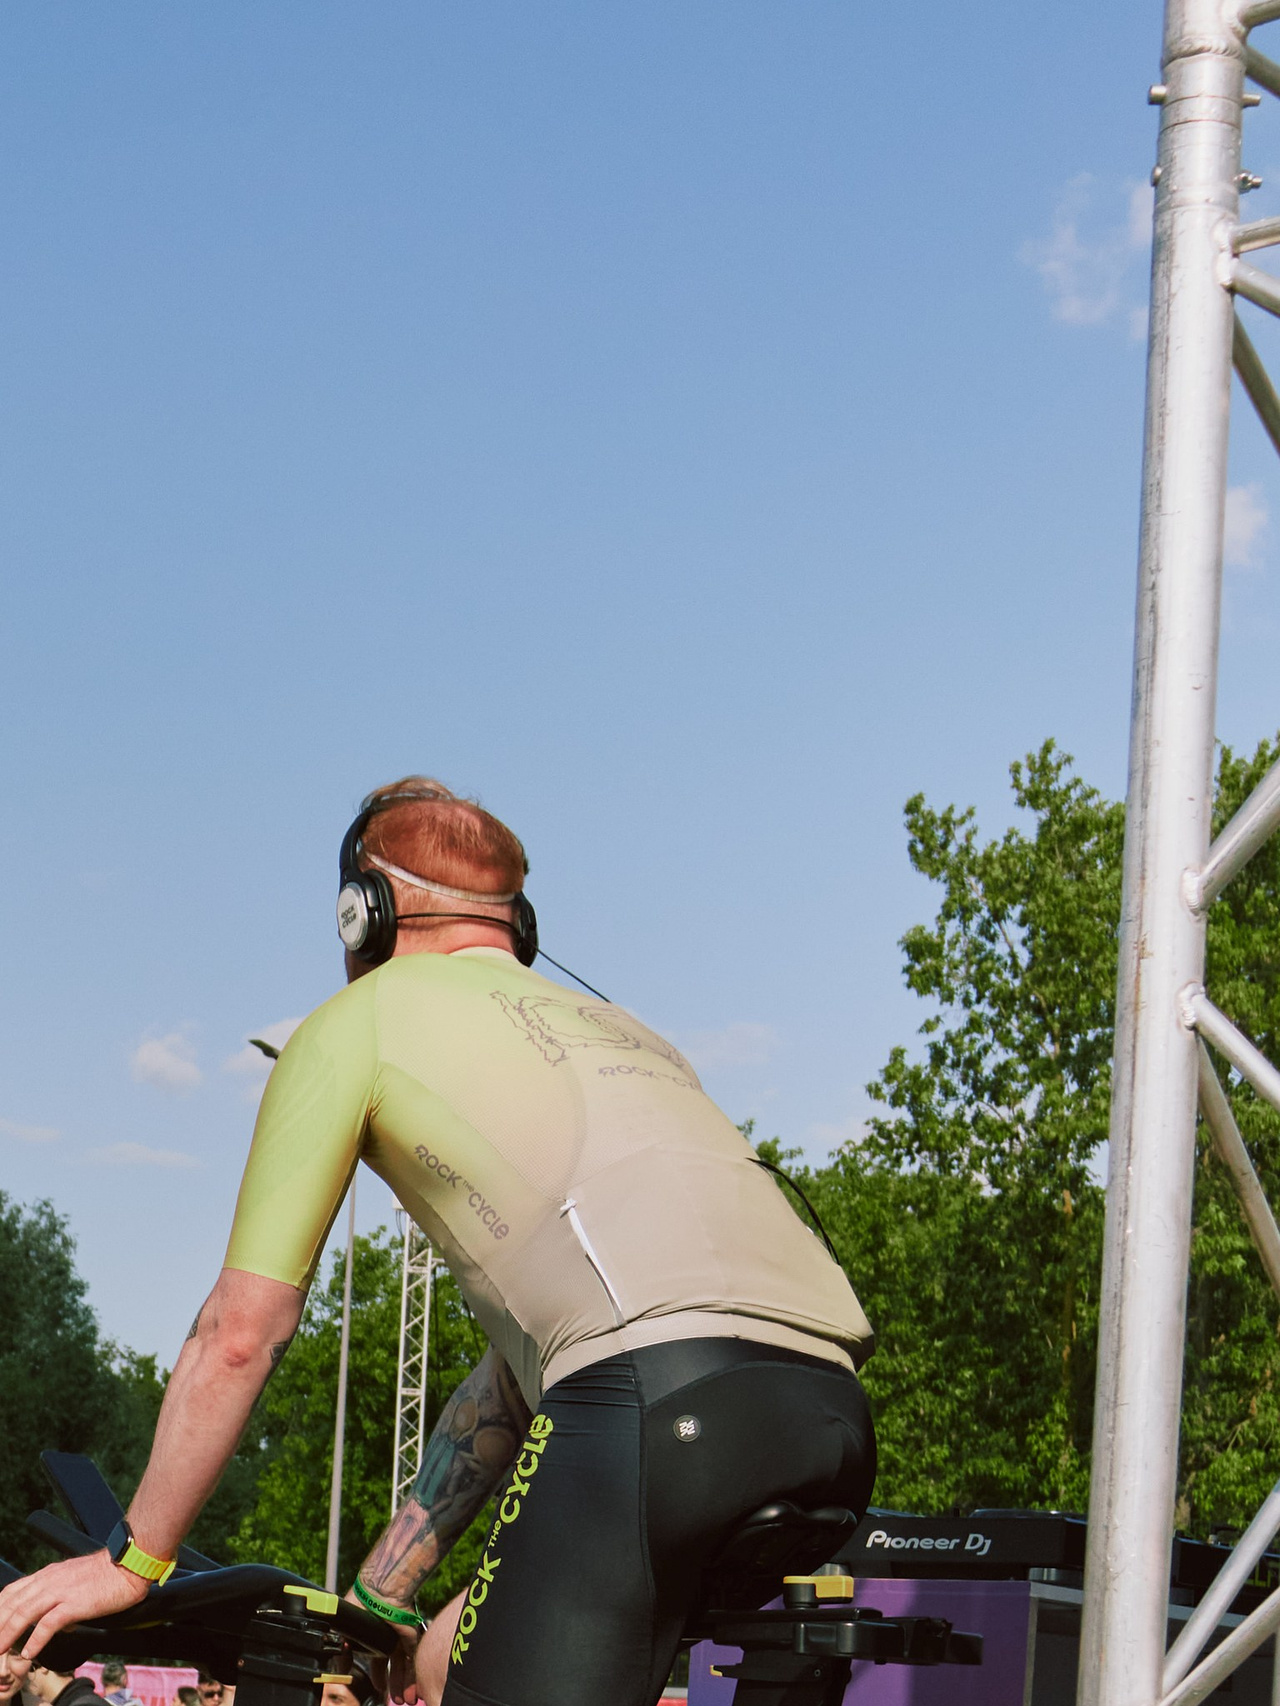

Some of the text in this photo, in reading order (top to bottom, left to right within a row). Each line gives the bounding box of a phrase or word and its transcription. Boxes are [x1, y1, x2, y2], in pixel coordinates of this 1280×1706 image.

[414, 1144, 462, 1189] ROCK
[866, 1530, 960, 1549] Pioneer
[451, 1550, 502, 1666] ROCK
